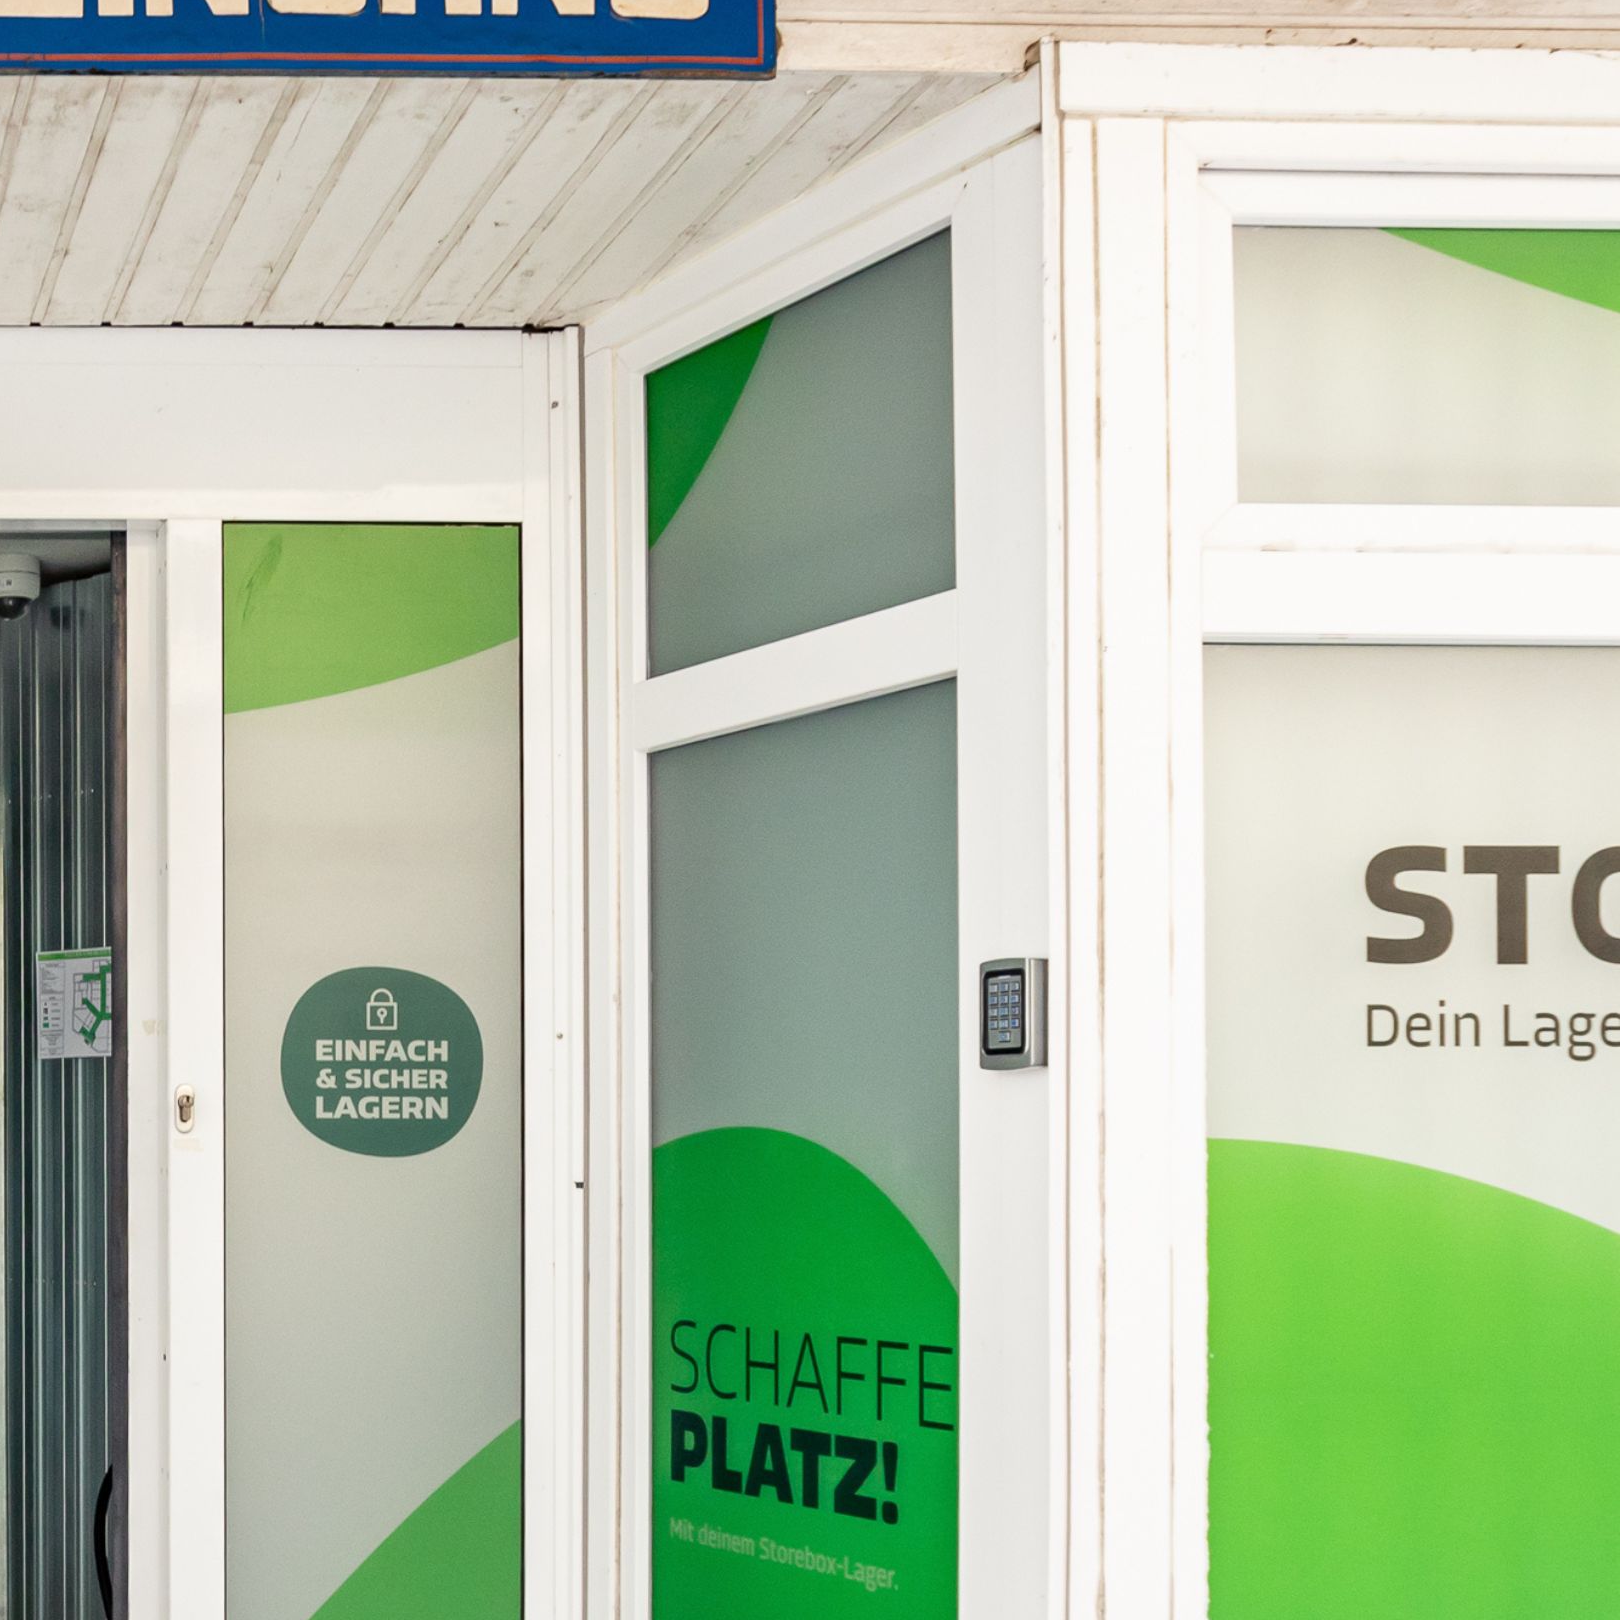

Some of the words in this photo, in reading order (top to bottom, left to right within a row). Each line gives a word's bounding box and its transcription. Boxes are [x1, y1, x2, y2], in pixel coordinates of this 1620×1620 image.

[1366, 999, 1480, 1048] Dein
[315, 1039, 449, 1062] EINFACH
[316, 1068, 337, 1089] &
[345, 1069, 448, 1089] SICHER
[315, 1096, 449, 1119] LAGERN
[670, 1319, 955, 1431] SCHAFFE
[670, 1409, 899, 1525] PLATZ!
[669, 1516, 695, 1543] Mit
[697, 1523, 756, 1558] deinem
